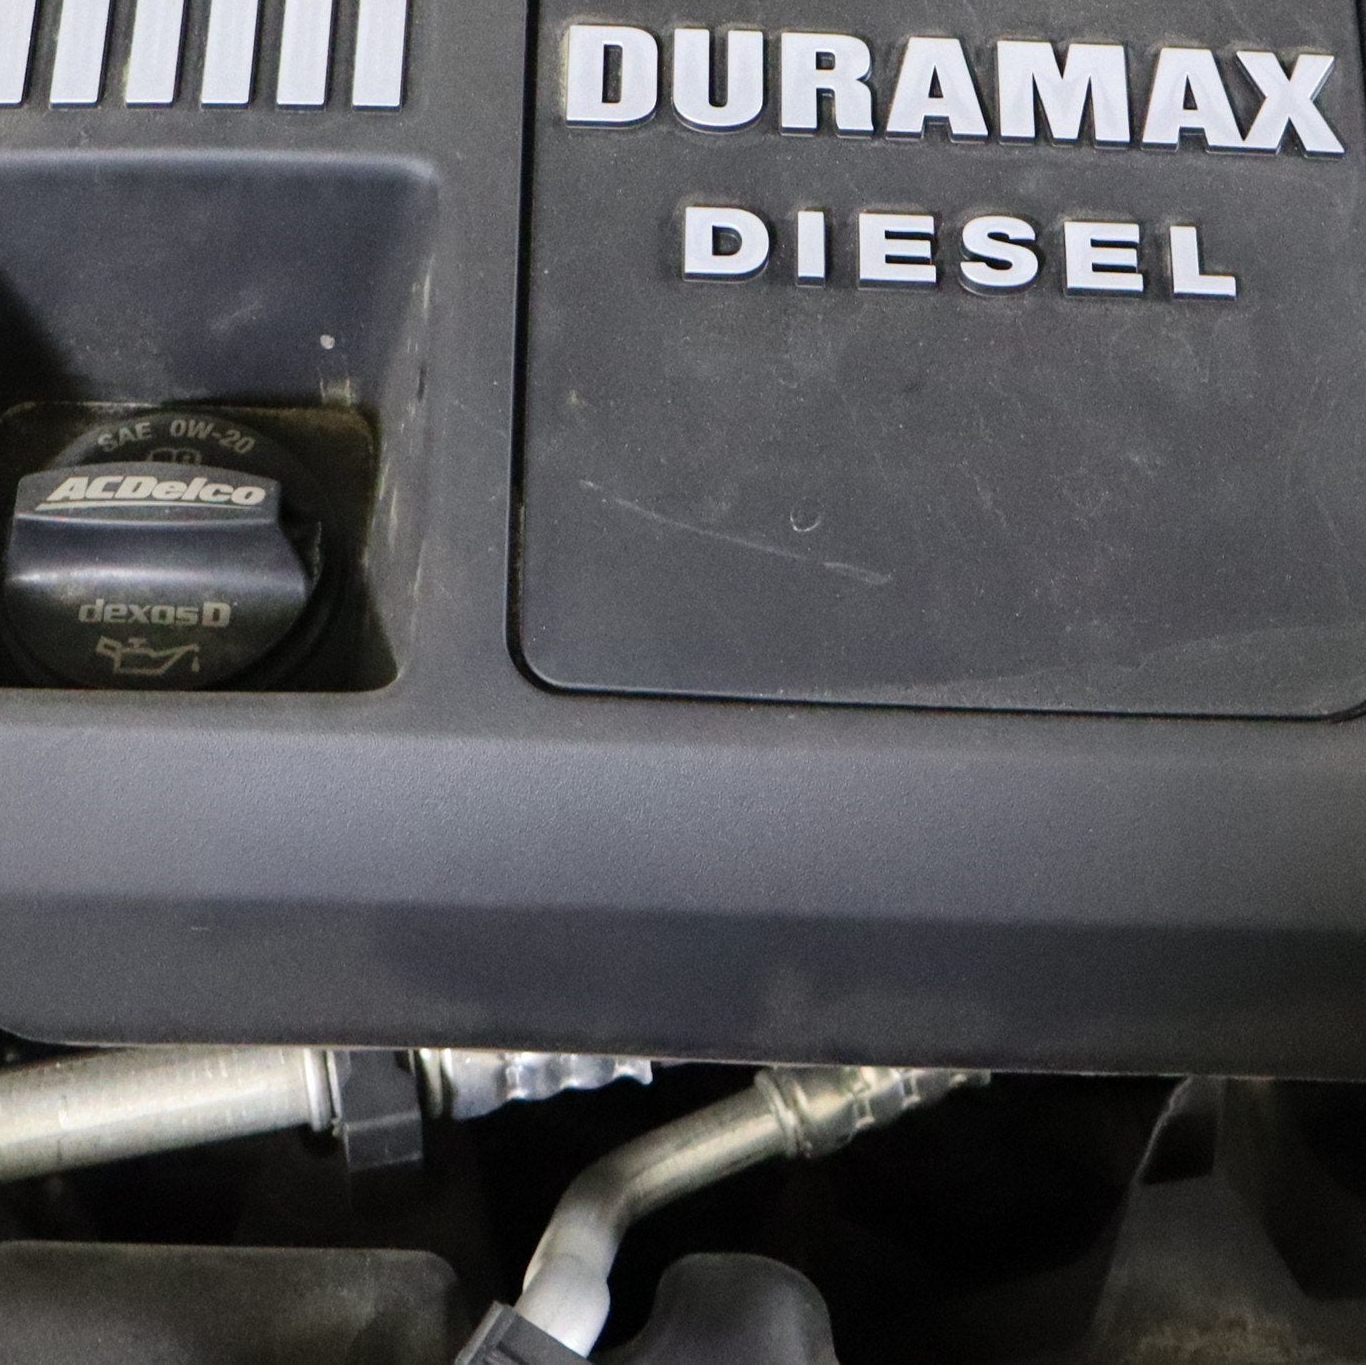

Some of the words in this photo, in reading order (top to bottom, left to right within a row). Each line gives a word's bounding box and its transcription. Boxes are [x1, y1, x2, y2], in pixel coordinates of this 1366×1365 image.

[564, 23, 1346, 159] DURAMAX
[681, 205, 1238, 300] DIESEL
[97, 420, 153, 453] SAE
[170, 418, 256, 456] 0W-20
[45, 475, 267, 507] ACDelco
[78, 597, 232, 628] dexosD
